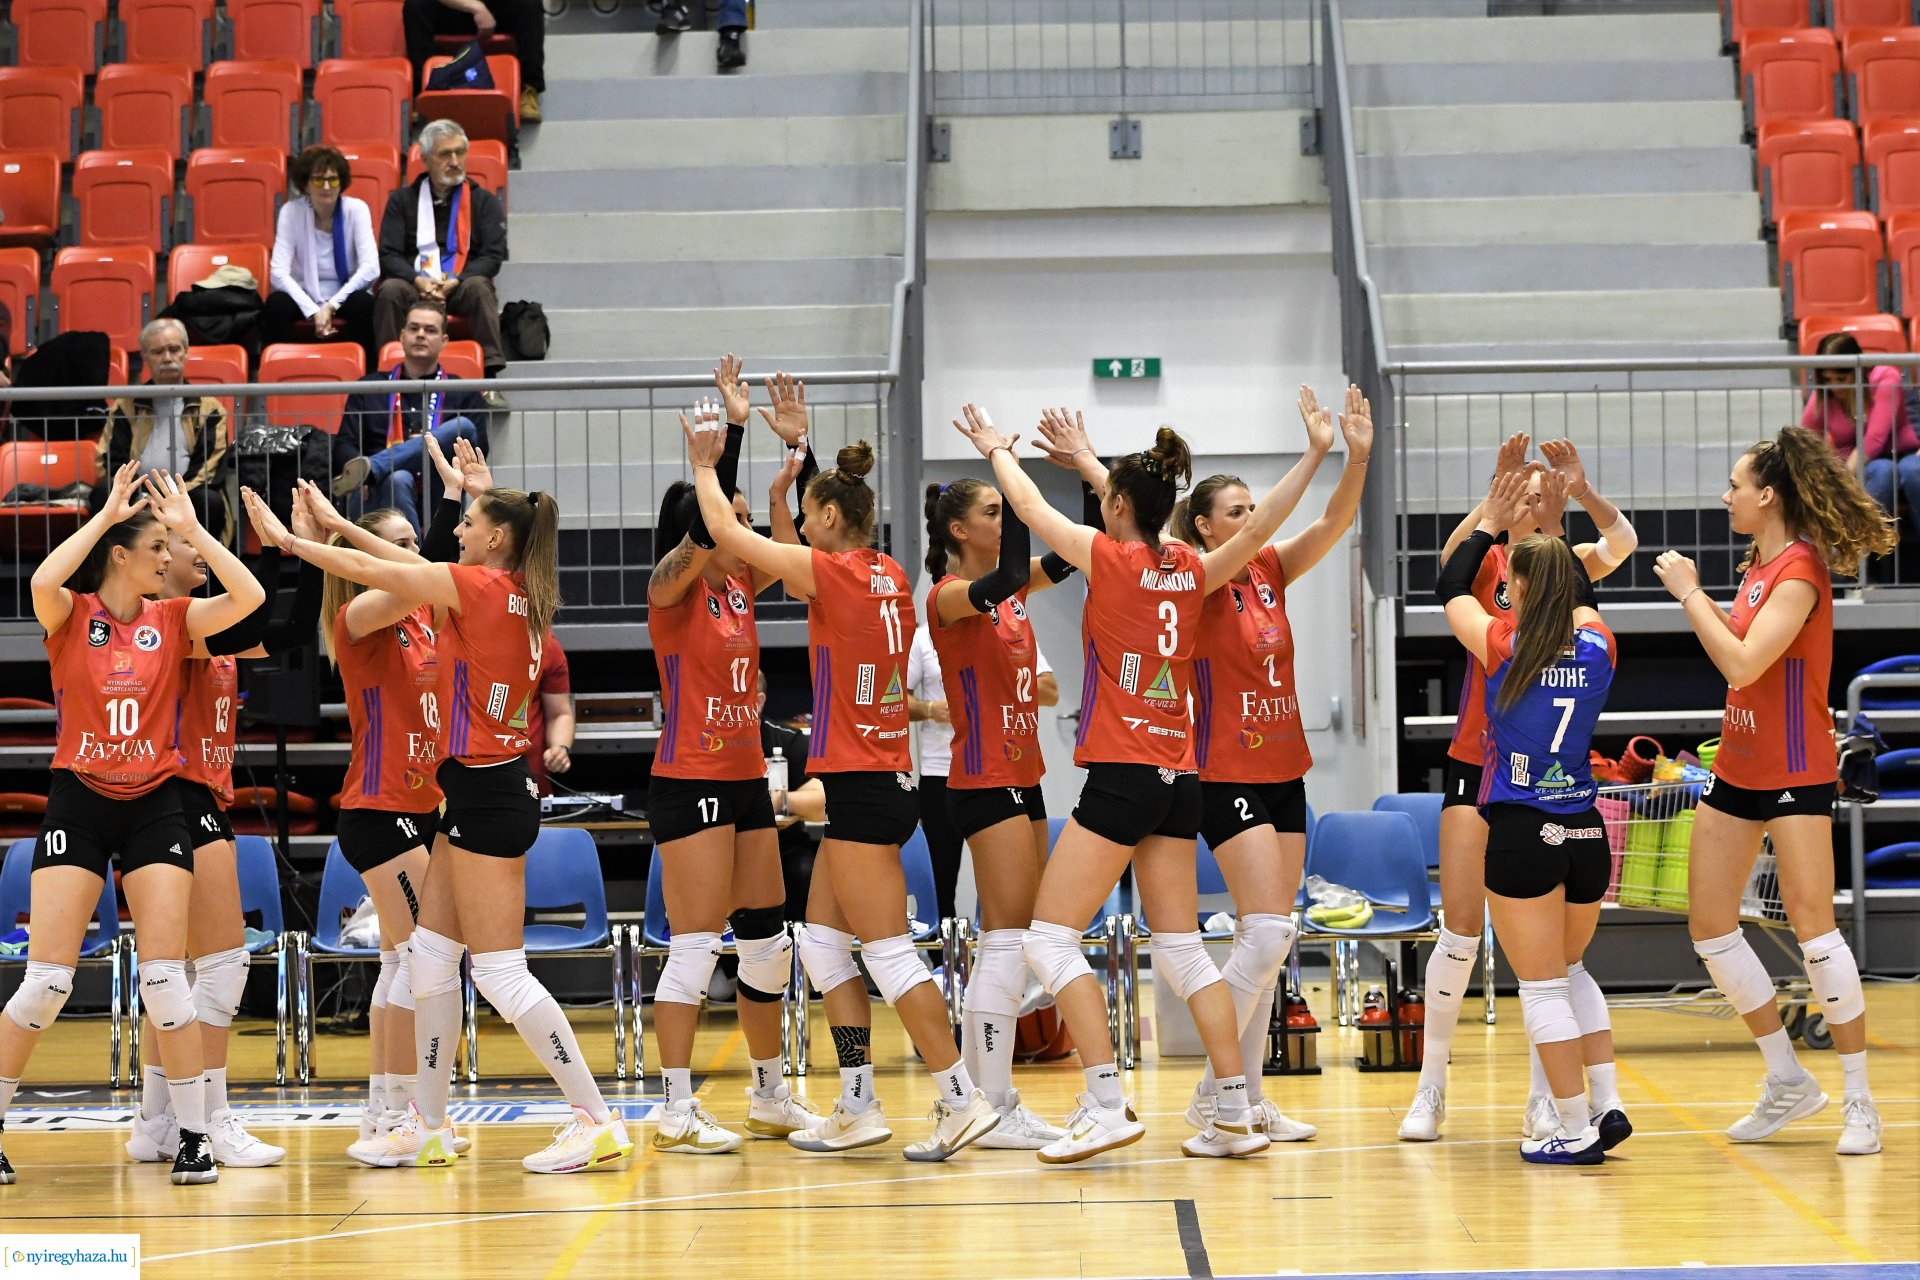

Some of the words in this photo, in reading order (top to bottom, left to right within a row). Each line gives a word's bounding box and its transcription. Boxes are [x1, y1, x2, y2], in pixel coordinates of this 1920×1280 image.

[1140, 568, 1196, 591] MILANOVA
[880, 599, 903, 655] 11
[1158, 601, 1178, 657] 3
[730, 658, 750, 693] 17
[860, 666, 871, 703] STRABAG
[1016, 666, 1033, 703] 12
[1124, 655, 1136, 692] STRABAG
[1263, 654, 1281, 687] 2
[1578, 667, 1589, 688] F.
[106, 698, 139, 736] 10
[215, 696, 231, 733] 13
[420, 692, 438, 728] 18
[491, 685, 504, 719] TRABAG
[1550, 698, 1576, 754] 7
[74, 755, 157, 763] PRPERTY
[698, 798, 719, 823] 17
[1234, 797, 1254, 821] 2
[45, 830, 67, 857] 10
